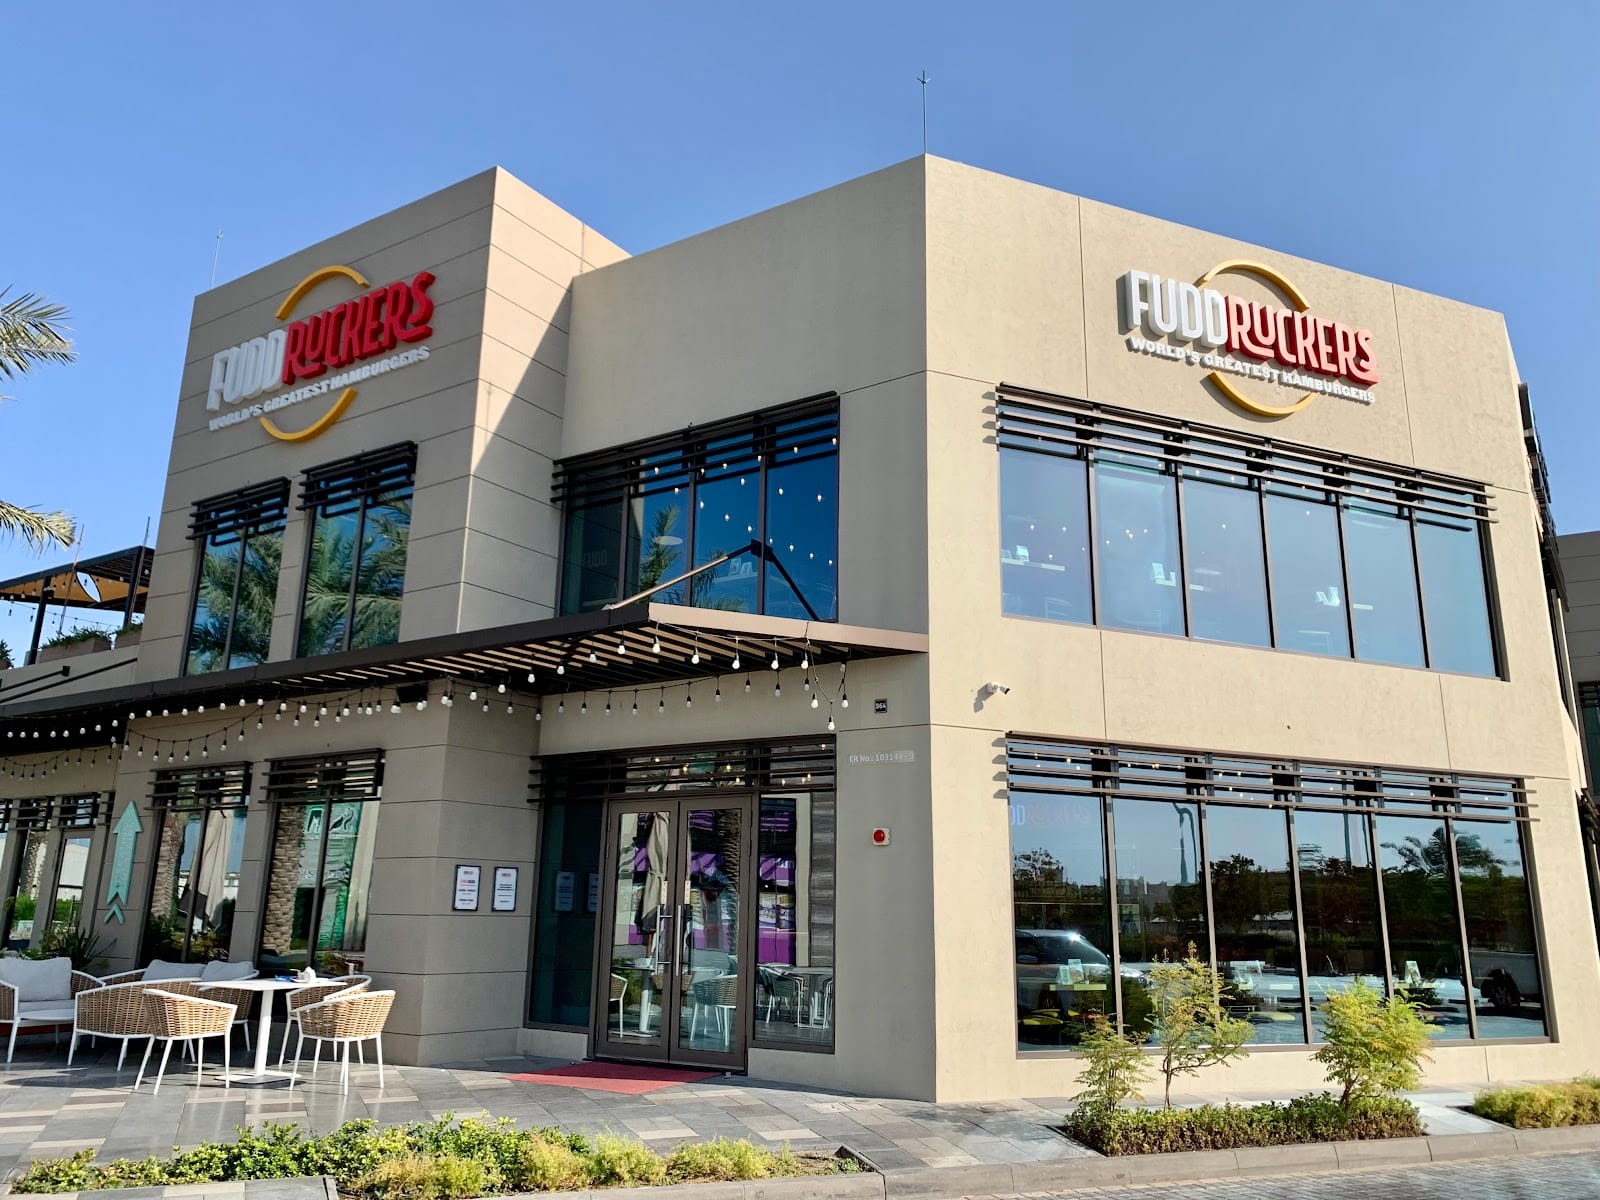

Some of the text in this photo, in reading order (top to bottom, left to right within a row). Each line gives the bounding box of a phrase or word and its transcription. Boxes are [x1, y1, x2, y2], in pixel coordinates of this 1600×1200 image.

[206, 271, 436, 412] FUDDRUCKERS
[1127, 269, 1380, 389] FUDDRUCKERS
[1128, 336, 1376, 404] WORLD'S GREATEST HAMBURGERS
[209, 346, 431, 431] WORLD'S GREATEST HAMBURGERS
